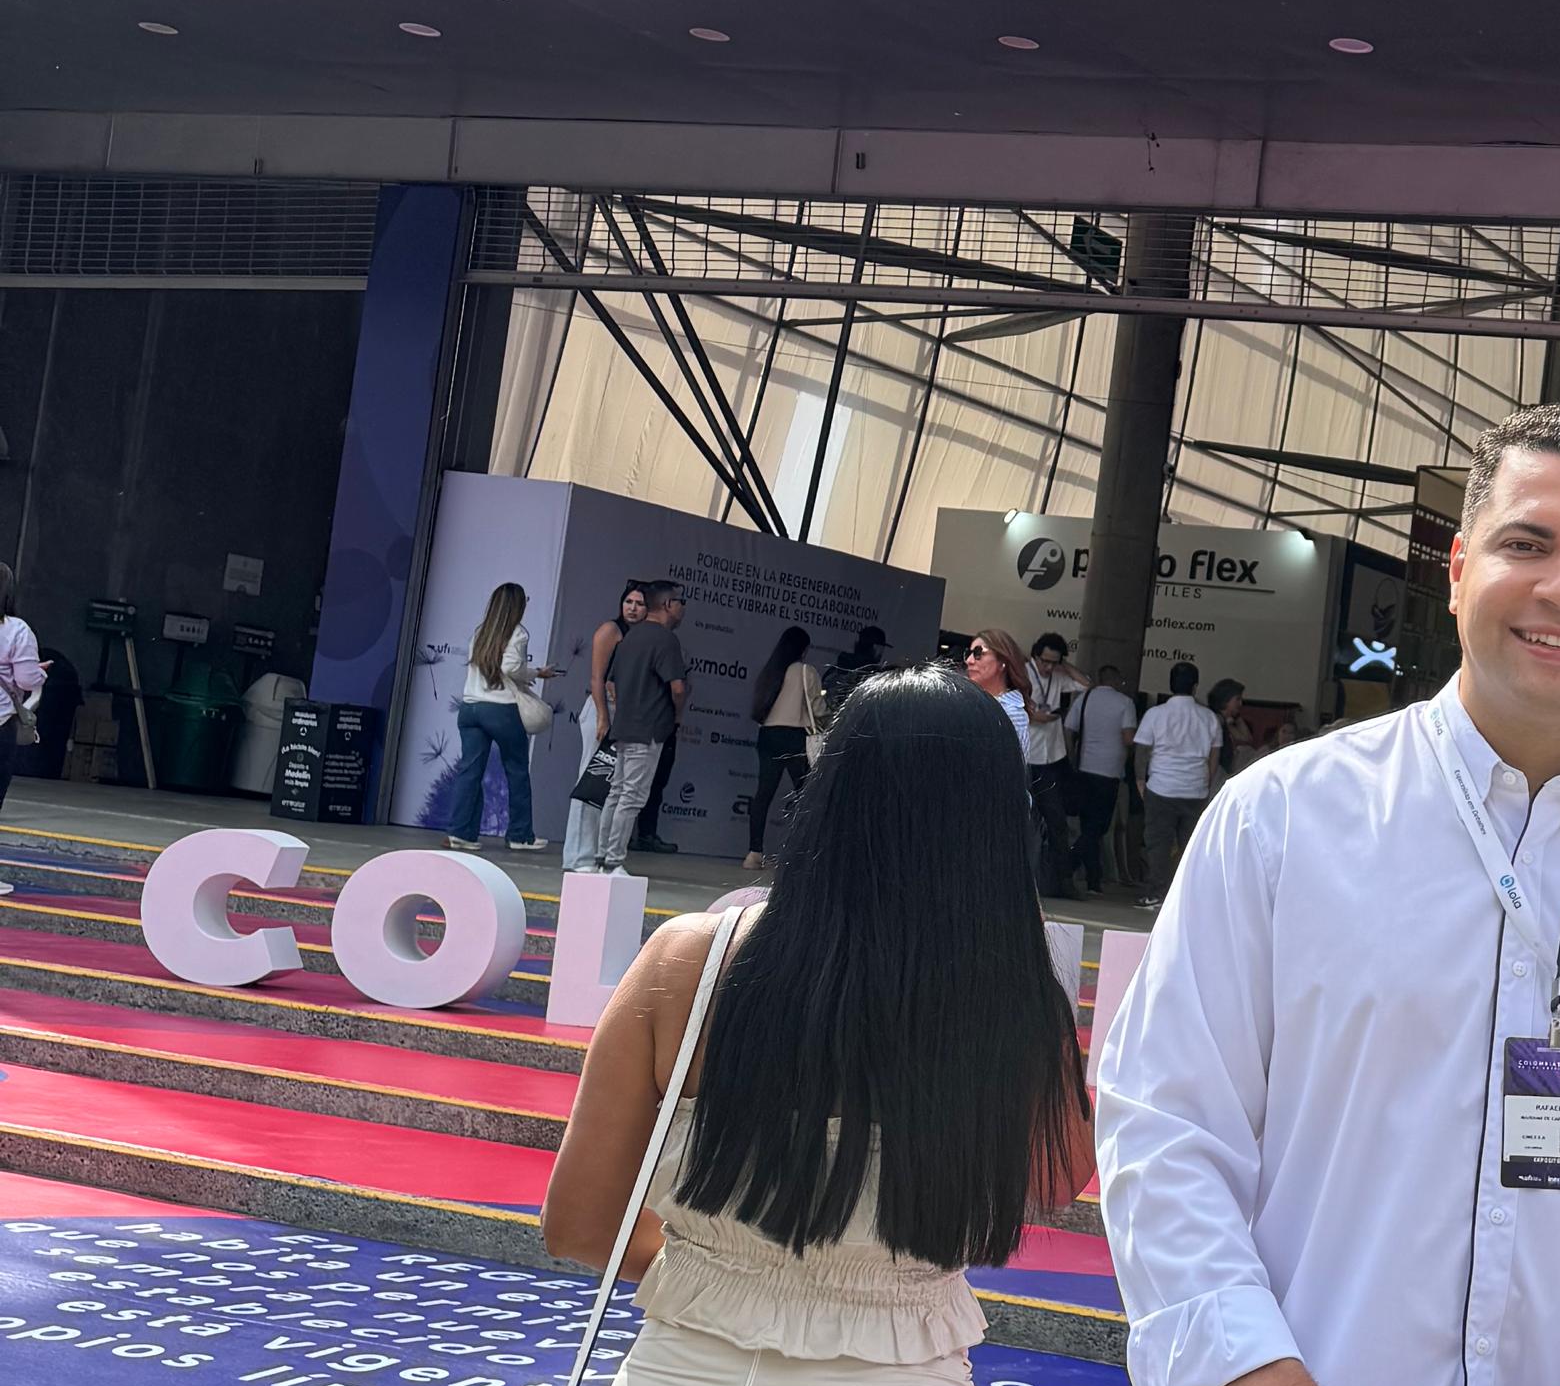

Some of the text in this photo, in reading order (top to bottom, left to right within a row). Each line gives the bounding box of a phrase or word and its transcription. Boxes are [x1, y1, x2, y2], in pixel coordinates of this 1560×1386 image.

[697, 552, 862, 601] PORQUE EN LA REGENERACIÓN
[1189, 549, 1259, 585] flex
[669, 564, 879, 622] HABITA UN ESPÍRITU DE COLABORACIÓN
[703, 590, 739, 609] HACE
[737, 596, 776, 617] VIBRAR
[779, 606, 790, 621] EL
[793, 609, 839, 628] SISTEMA
[1508, 887, 1522, 909] lola
[269, 1235, 359, 1253] En
[3, 1221, 139, 1250] que
[163, 1252, 306, 1279] nos
[307, 1280, 638, 1342] permite
[115, 1222, 351, 1272] habita
[375, 1271, 468, 1292] un
[510, 1290, 646, 1324] esp
[34, 1246, 358, 1309] sembrar
[372, 1310, 628, 1362] nueva
[49, 1270, 537, 1367] establecido
[57, 1297, 245, 1338] está
